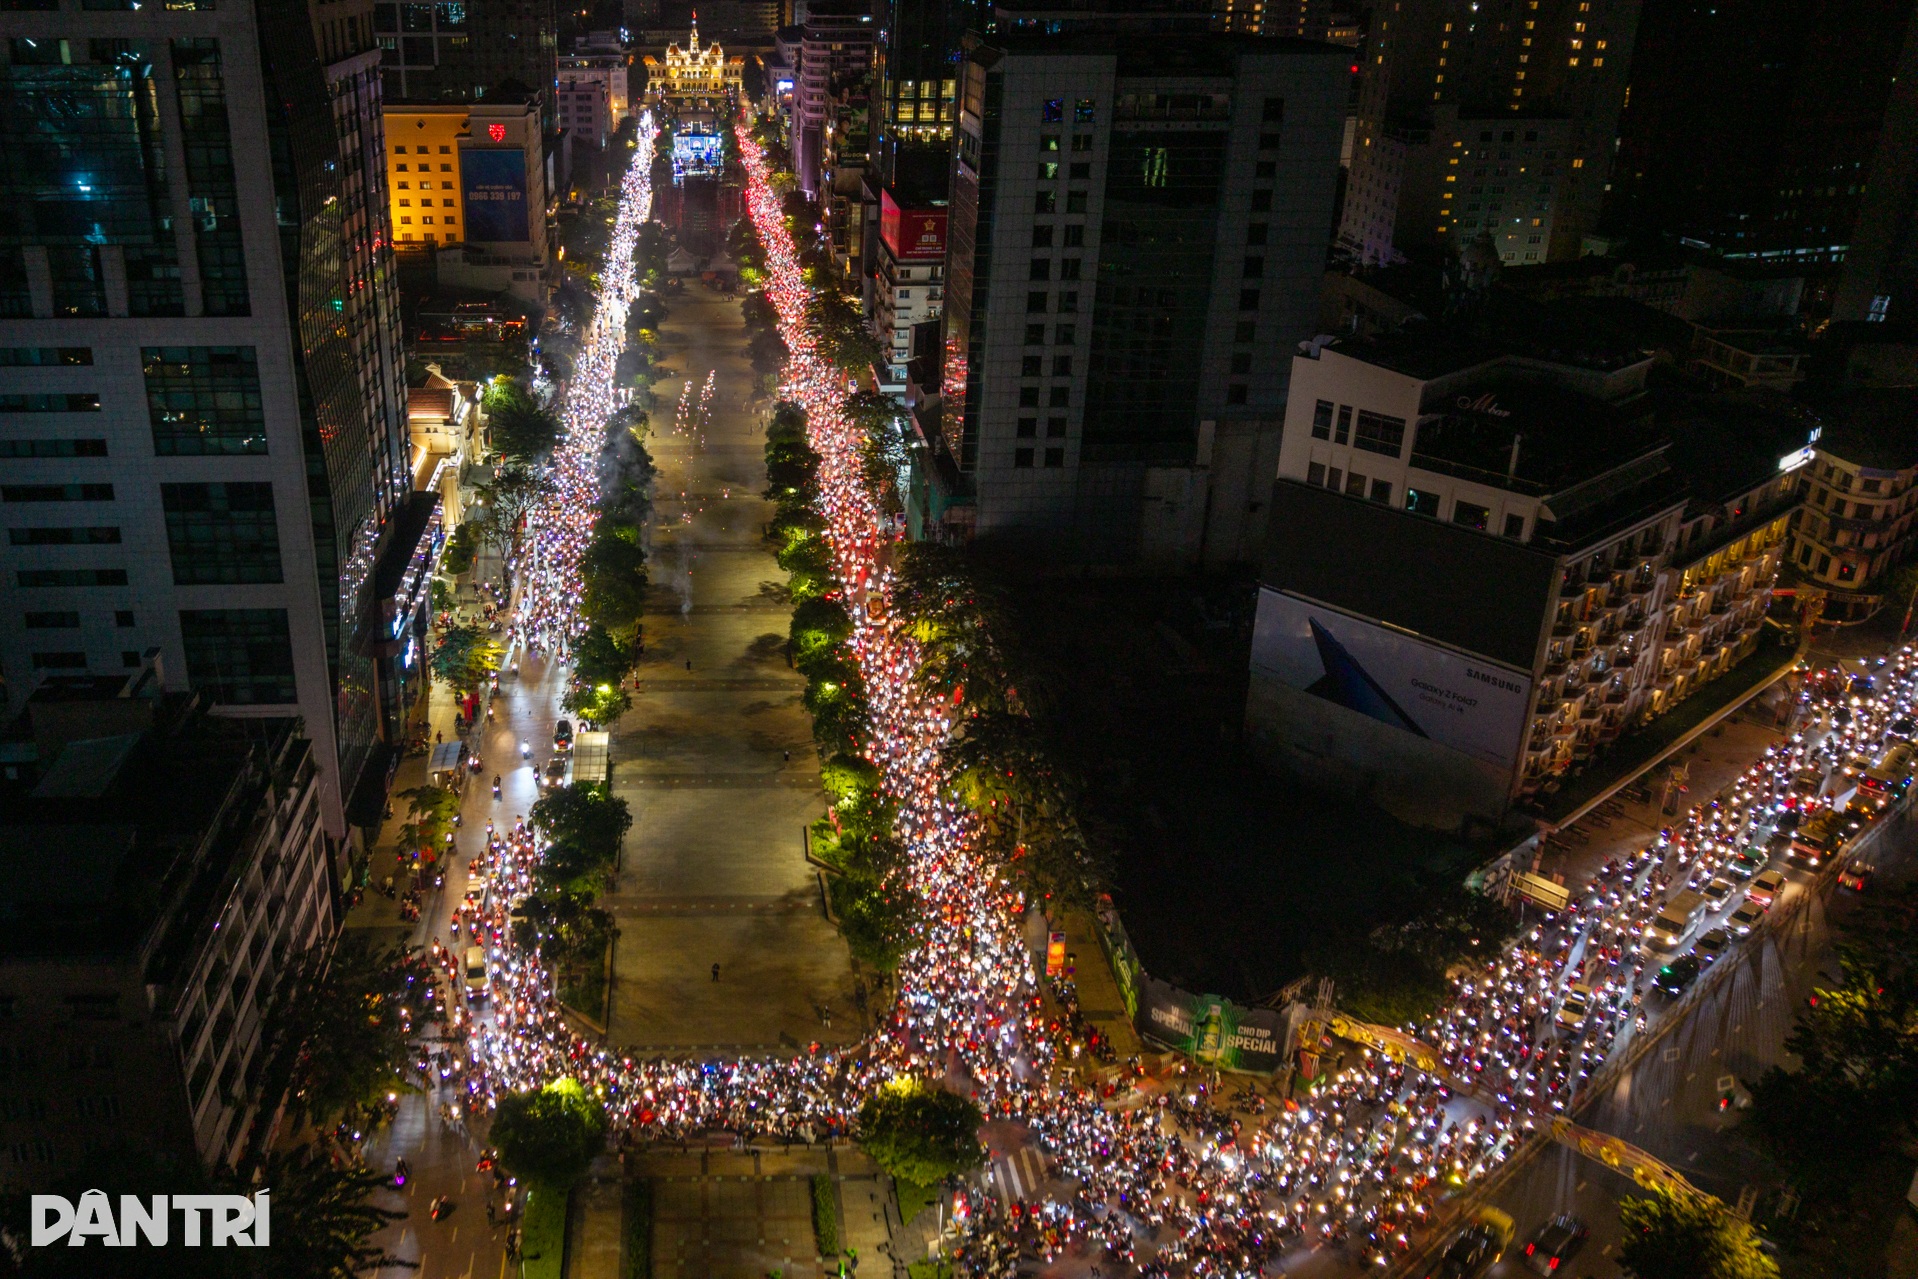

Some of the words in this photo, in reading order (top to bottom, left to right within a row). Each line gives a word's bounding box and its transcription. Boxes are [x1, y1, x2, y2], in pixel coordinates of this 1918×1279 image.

[1411, 678, 1444, 696] Galaxy
[1446, 690, 1452, 698] Z
[1452, 692, 1478, 707] Fold7
[1466, 668, 1522, 694] SAMSUNG
[1151, 1008, 1194, 1038] SPECIAL
[1238, 1026, 1255, 1037] CHO
[1227, 1035, 1277, 1054] SPECIAL
